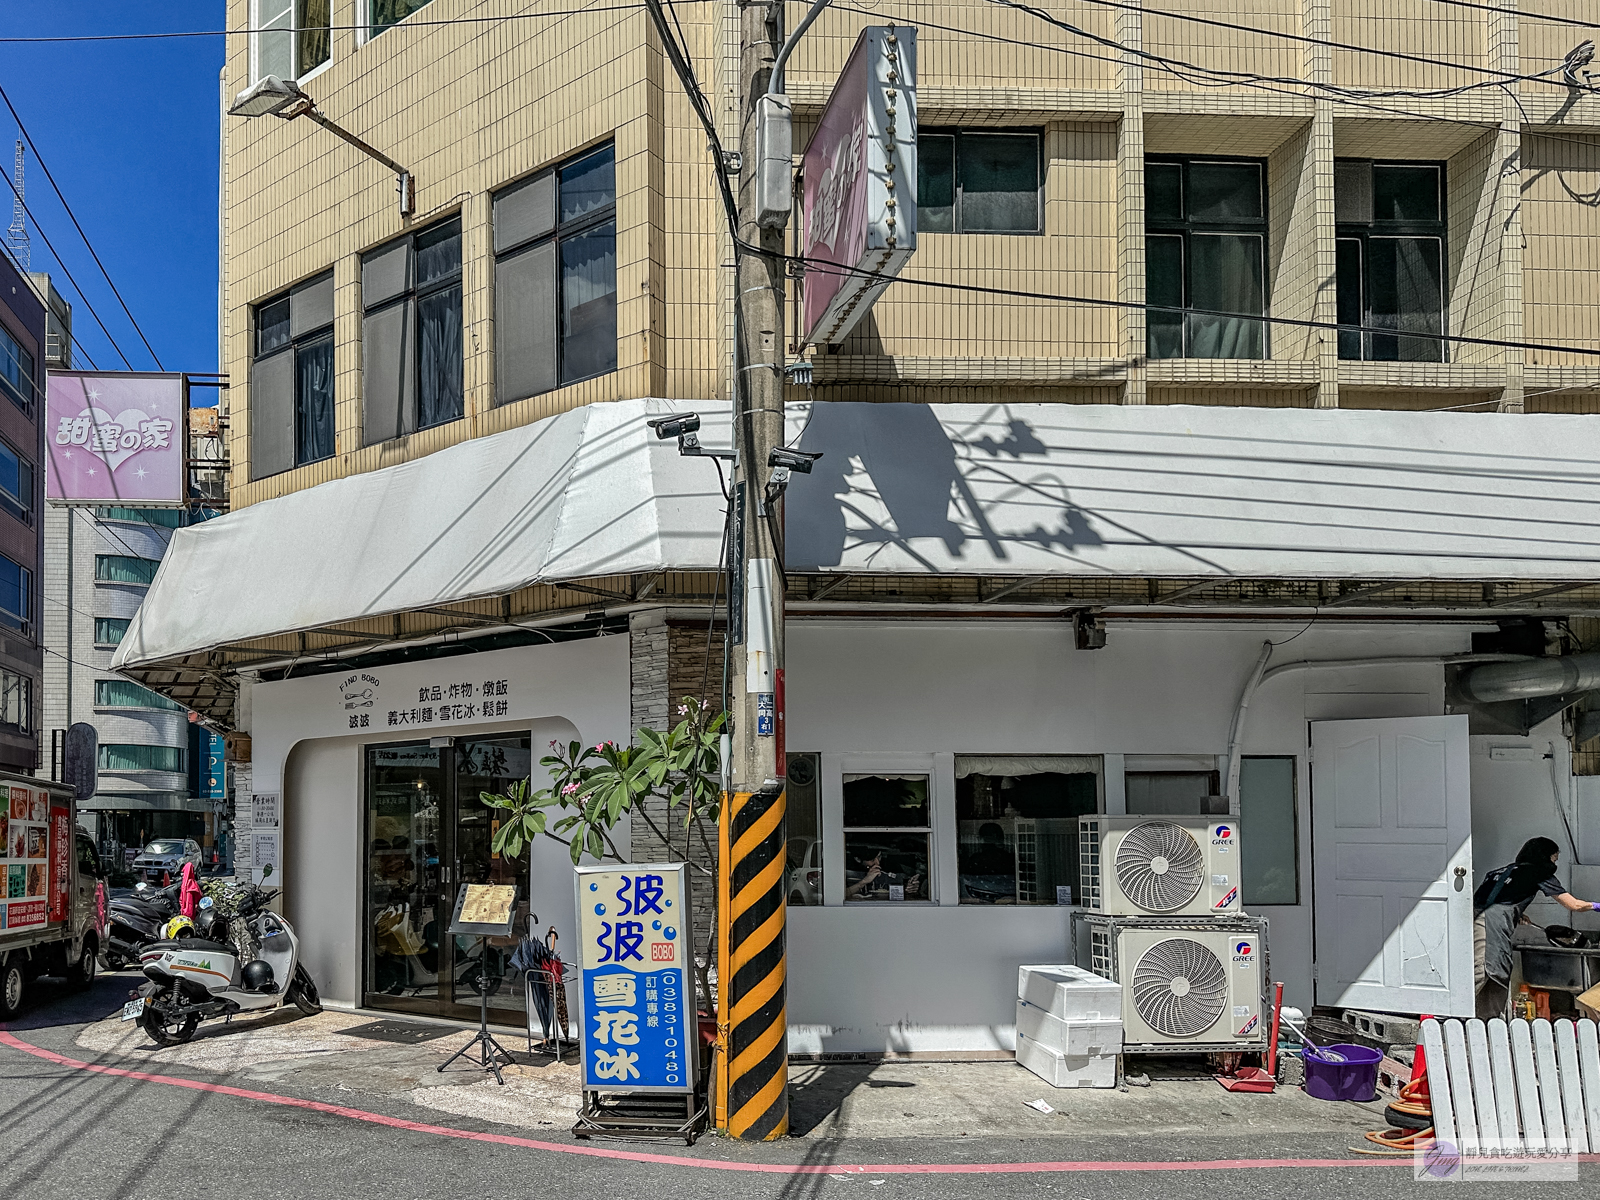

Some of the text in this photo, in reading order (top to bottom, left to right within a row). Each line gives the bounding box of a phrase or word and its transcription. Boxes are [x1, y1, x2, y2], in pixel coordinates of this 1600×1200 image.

[56, 416, 173, 453] 甜蜜の家
[339, 674, 380, 692] FIND BOBO
[349, 713, 370, 729] 波波
[597, 873, 664, 963] 波波
[652, 944, 674, 960] BOBO
[645, 976, 659, 1027] 訂購專線
[593, 973, 640, 1082] 雪花冰
[661, 971, 680, 1084] (03)8310480
